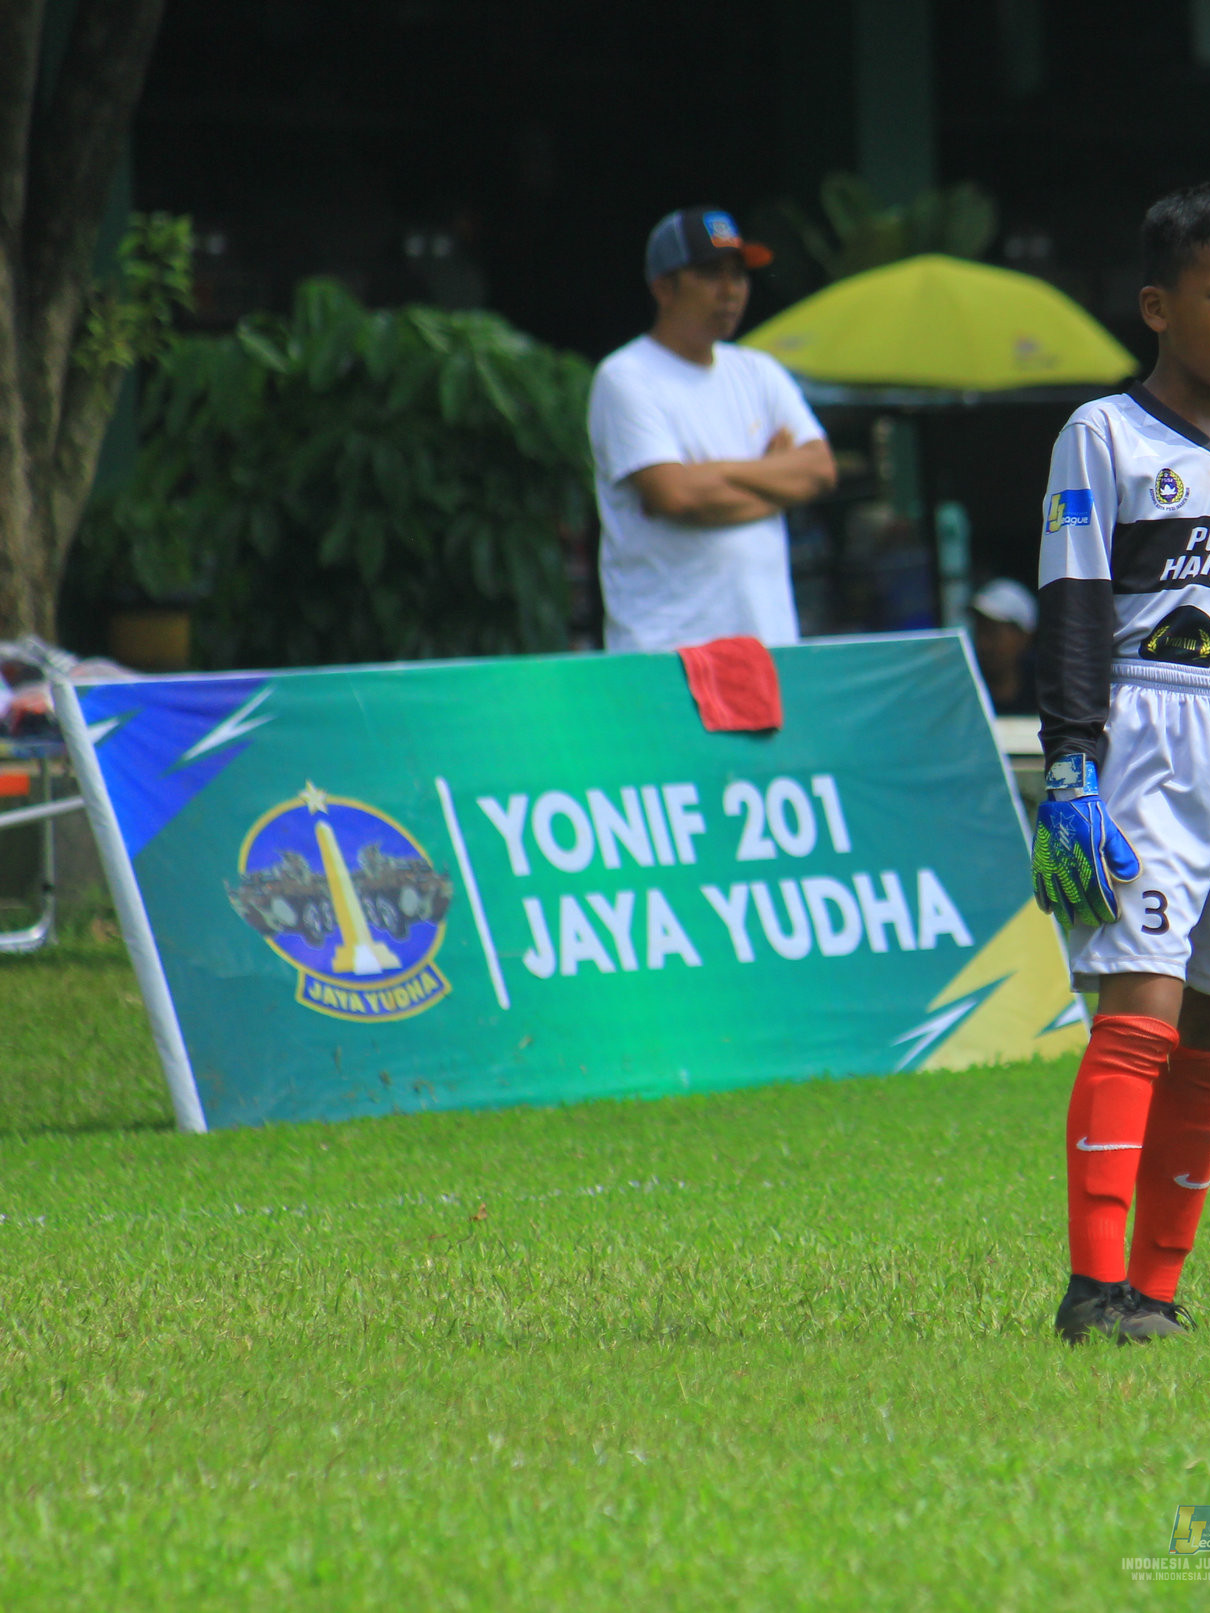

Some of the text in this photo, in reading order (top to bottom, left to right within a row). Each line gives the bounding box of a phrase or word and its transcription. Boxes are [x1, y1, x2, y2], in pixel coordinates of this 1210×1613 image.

[476, 774, 852, 877] YONIF 201
[522, 867, 974, 980] JAYA YUDHA
[1140, 889, 1170, 936] 3
[308, 971, 438, 1014] JAYA YUDHA
